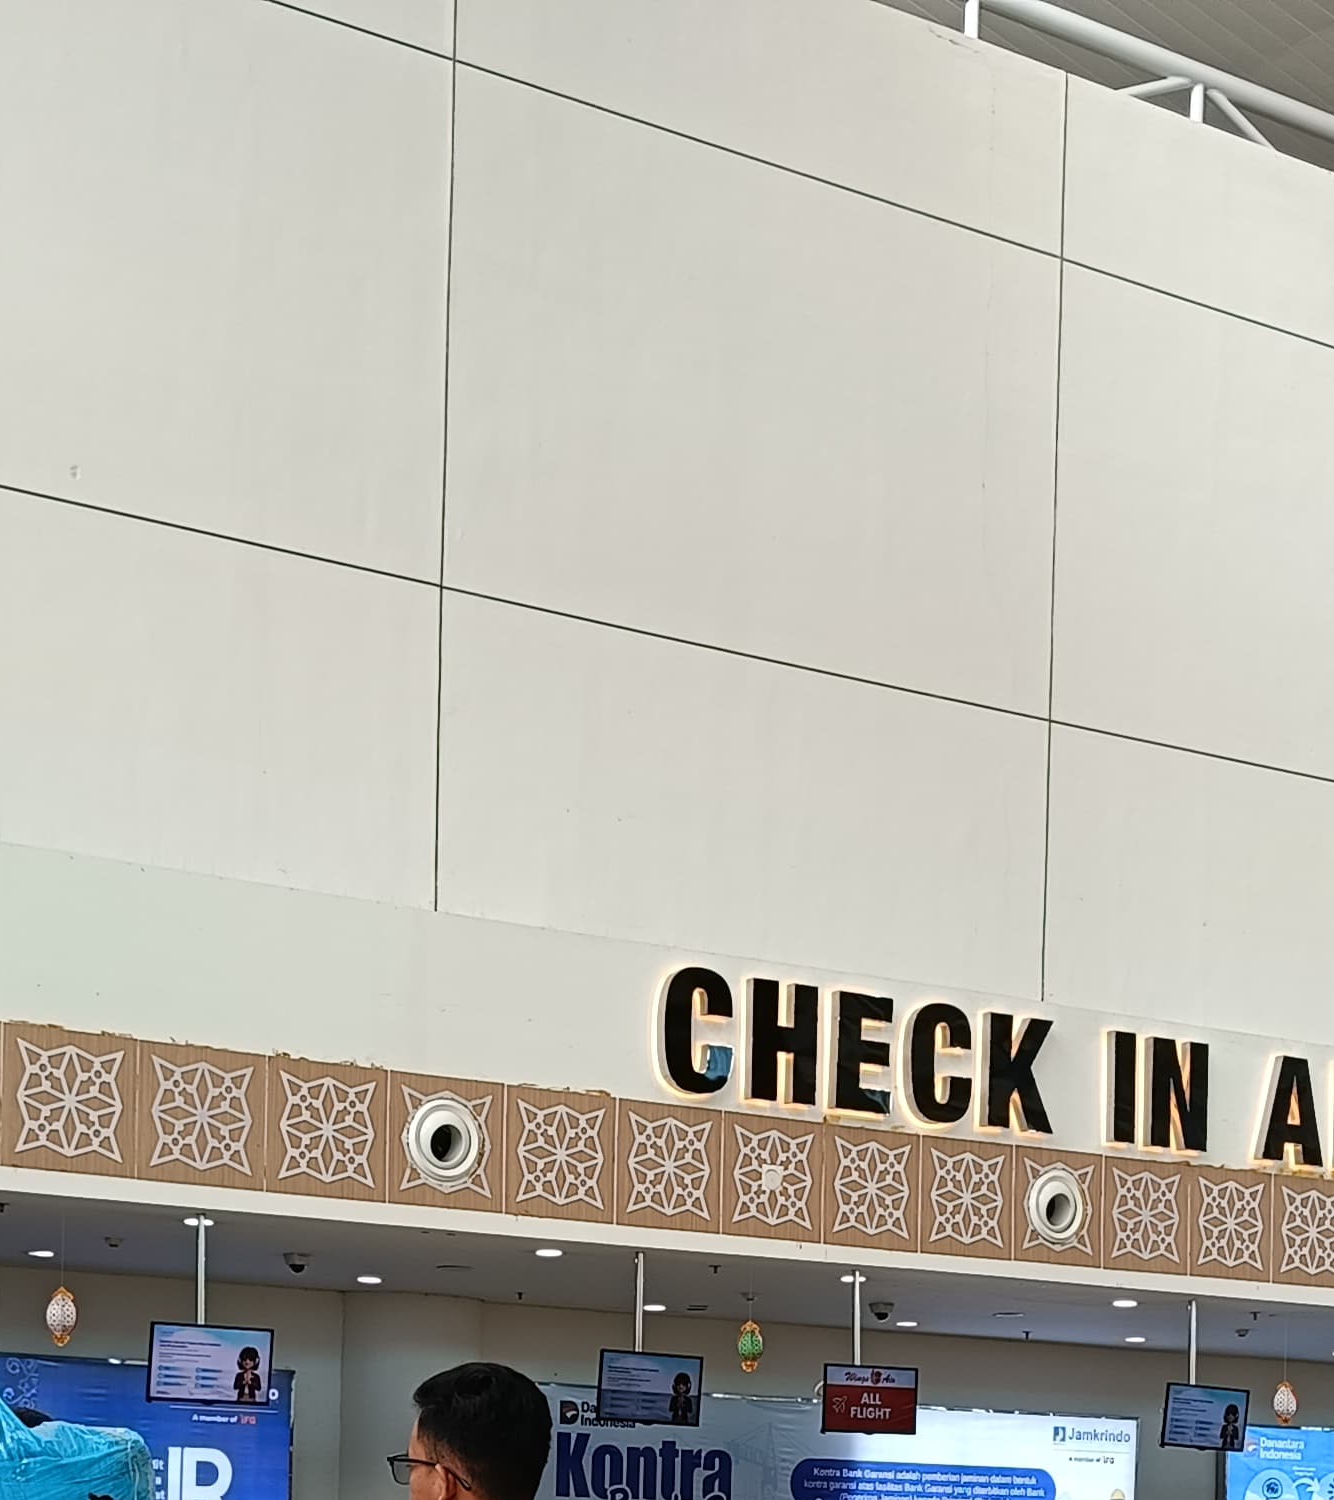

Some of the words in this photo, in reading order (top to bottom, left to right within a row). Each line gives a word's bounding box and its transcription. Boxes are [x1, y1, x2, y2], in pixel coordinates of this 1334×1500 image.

[661, 966, 1054, 1135] CHECK
[1106, 1029, 1210, 1152] IN
[861, 1392, 882, 1405] ALL
[850, 1407, 891, 1419] FLIGHT
[1068, 1427, 1131, 1443] Jamkrindo
[1260, 1437, 1305, 1450] Danantara
[1260, 1448, 1302, 1460] Indonesia
[813, 1468, 840, 1476] Kontra
[843, 1469, 862, 1477] Bank
